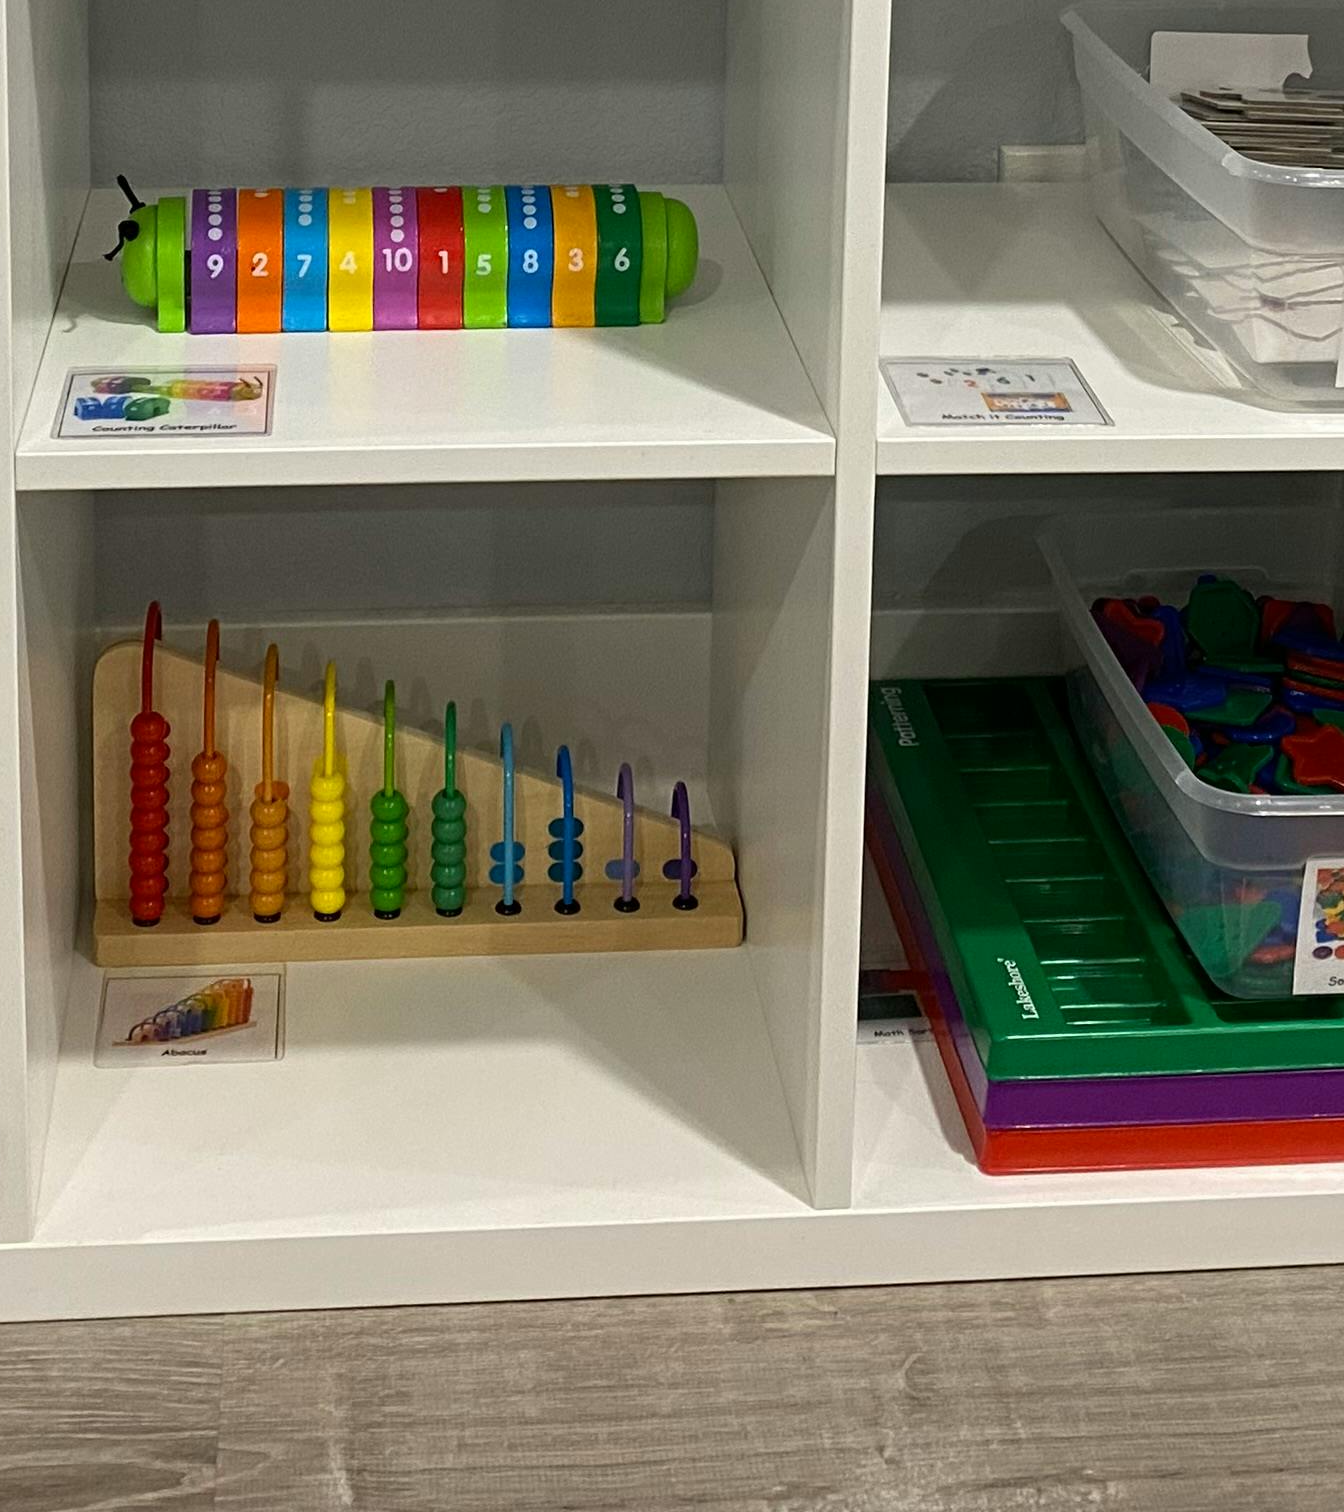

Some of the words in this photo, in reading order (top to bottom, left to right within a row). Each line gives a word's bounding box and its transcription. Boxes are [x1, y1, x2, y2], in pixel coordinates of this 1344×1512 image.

[206, 254, 224, 279] 9
[251, 253, 269, 277] 2
[296, 254, 313, 278] 7
[339, 250, 358, 273] 4
[383, 247, 413, 272] 10
[438, 250, 449, 274] 1
[476, 254, 492, 276] 5
[522, 250, 539, 274] 8
[568, 248, 585, 272] 3
[614, 247, 631, 272] 6
[1005, 413, 1065, 421] Counting
[92, 424, 155, 432] Counting
[159, 423, 237, 431] Caterpillar
[1003, 959, 1040, 1019] Lakeshore
[161, 1049, 208, 1057] Abacus
